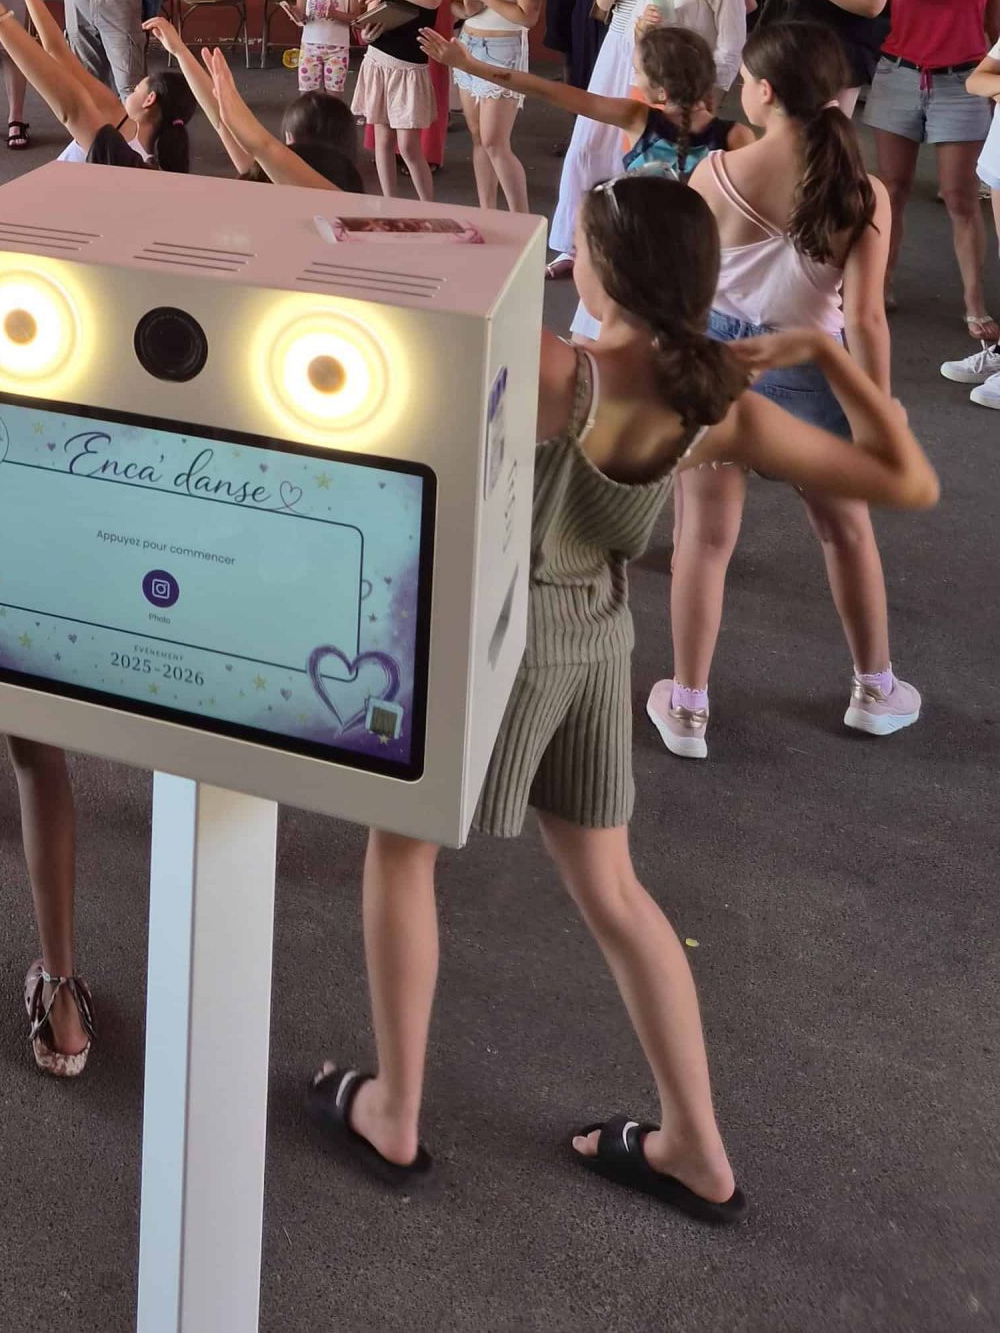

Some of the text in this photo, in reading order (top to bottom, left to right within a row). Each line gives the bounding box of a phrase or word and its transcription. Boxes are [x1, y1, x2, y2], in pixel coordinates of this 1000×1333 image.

[174, 448, 271, 503] danse
[97, 530, 237, 566] Appuyez pour commencer
[148, 612, 171, 625] Photo
[110, 652, 205, 686] 2025-2026
